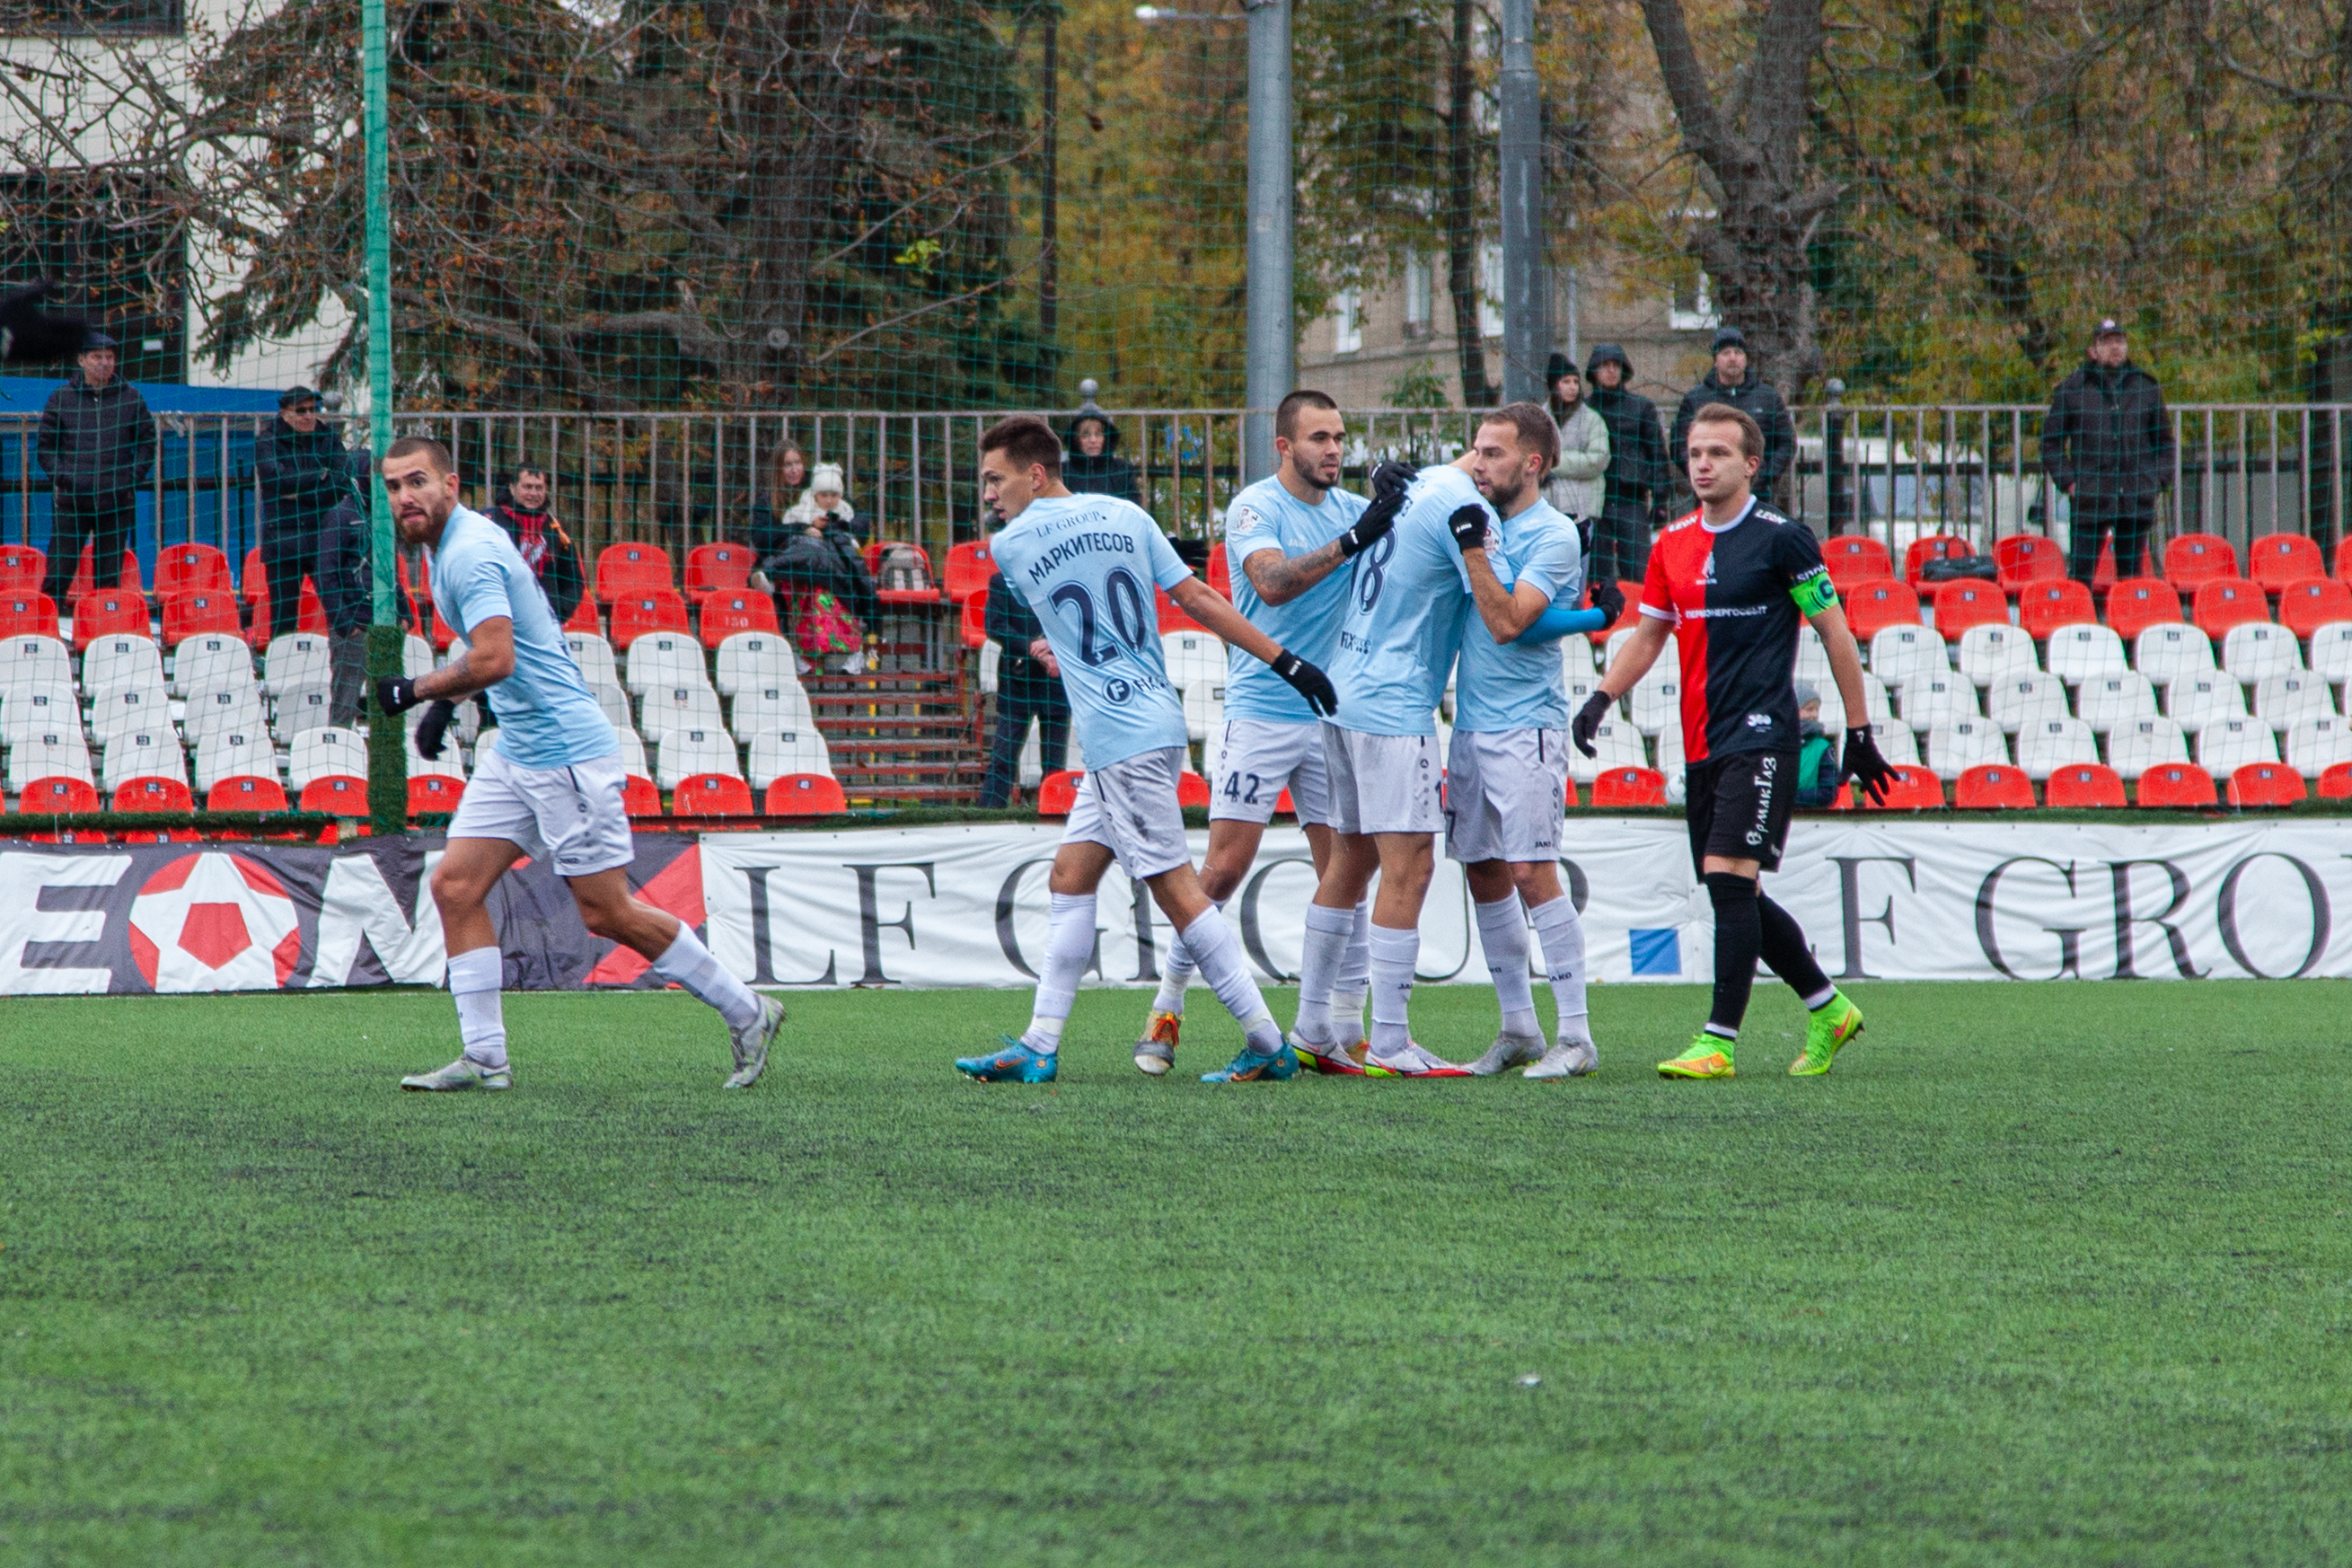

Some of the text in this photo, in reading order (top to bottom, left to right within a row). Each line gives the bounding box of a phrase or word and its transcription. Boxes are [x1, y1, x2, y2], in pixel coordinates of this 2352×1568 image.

[1028, 532, 1134, 586] МАРКИТЕСОВ
[1047, 566, 1148, 667] 20
[1224, 771, 1260, 805] 42
[1975, 851, 2352, 981] GRO
